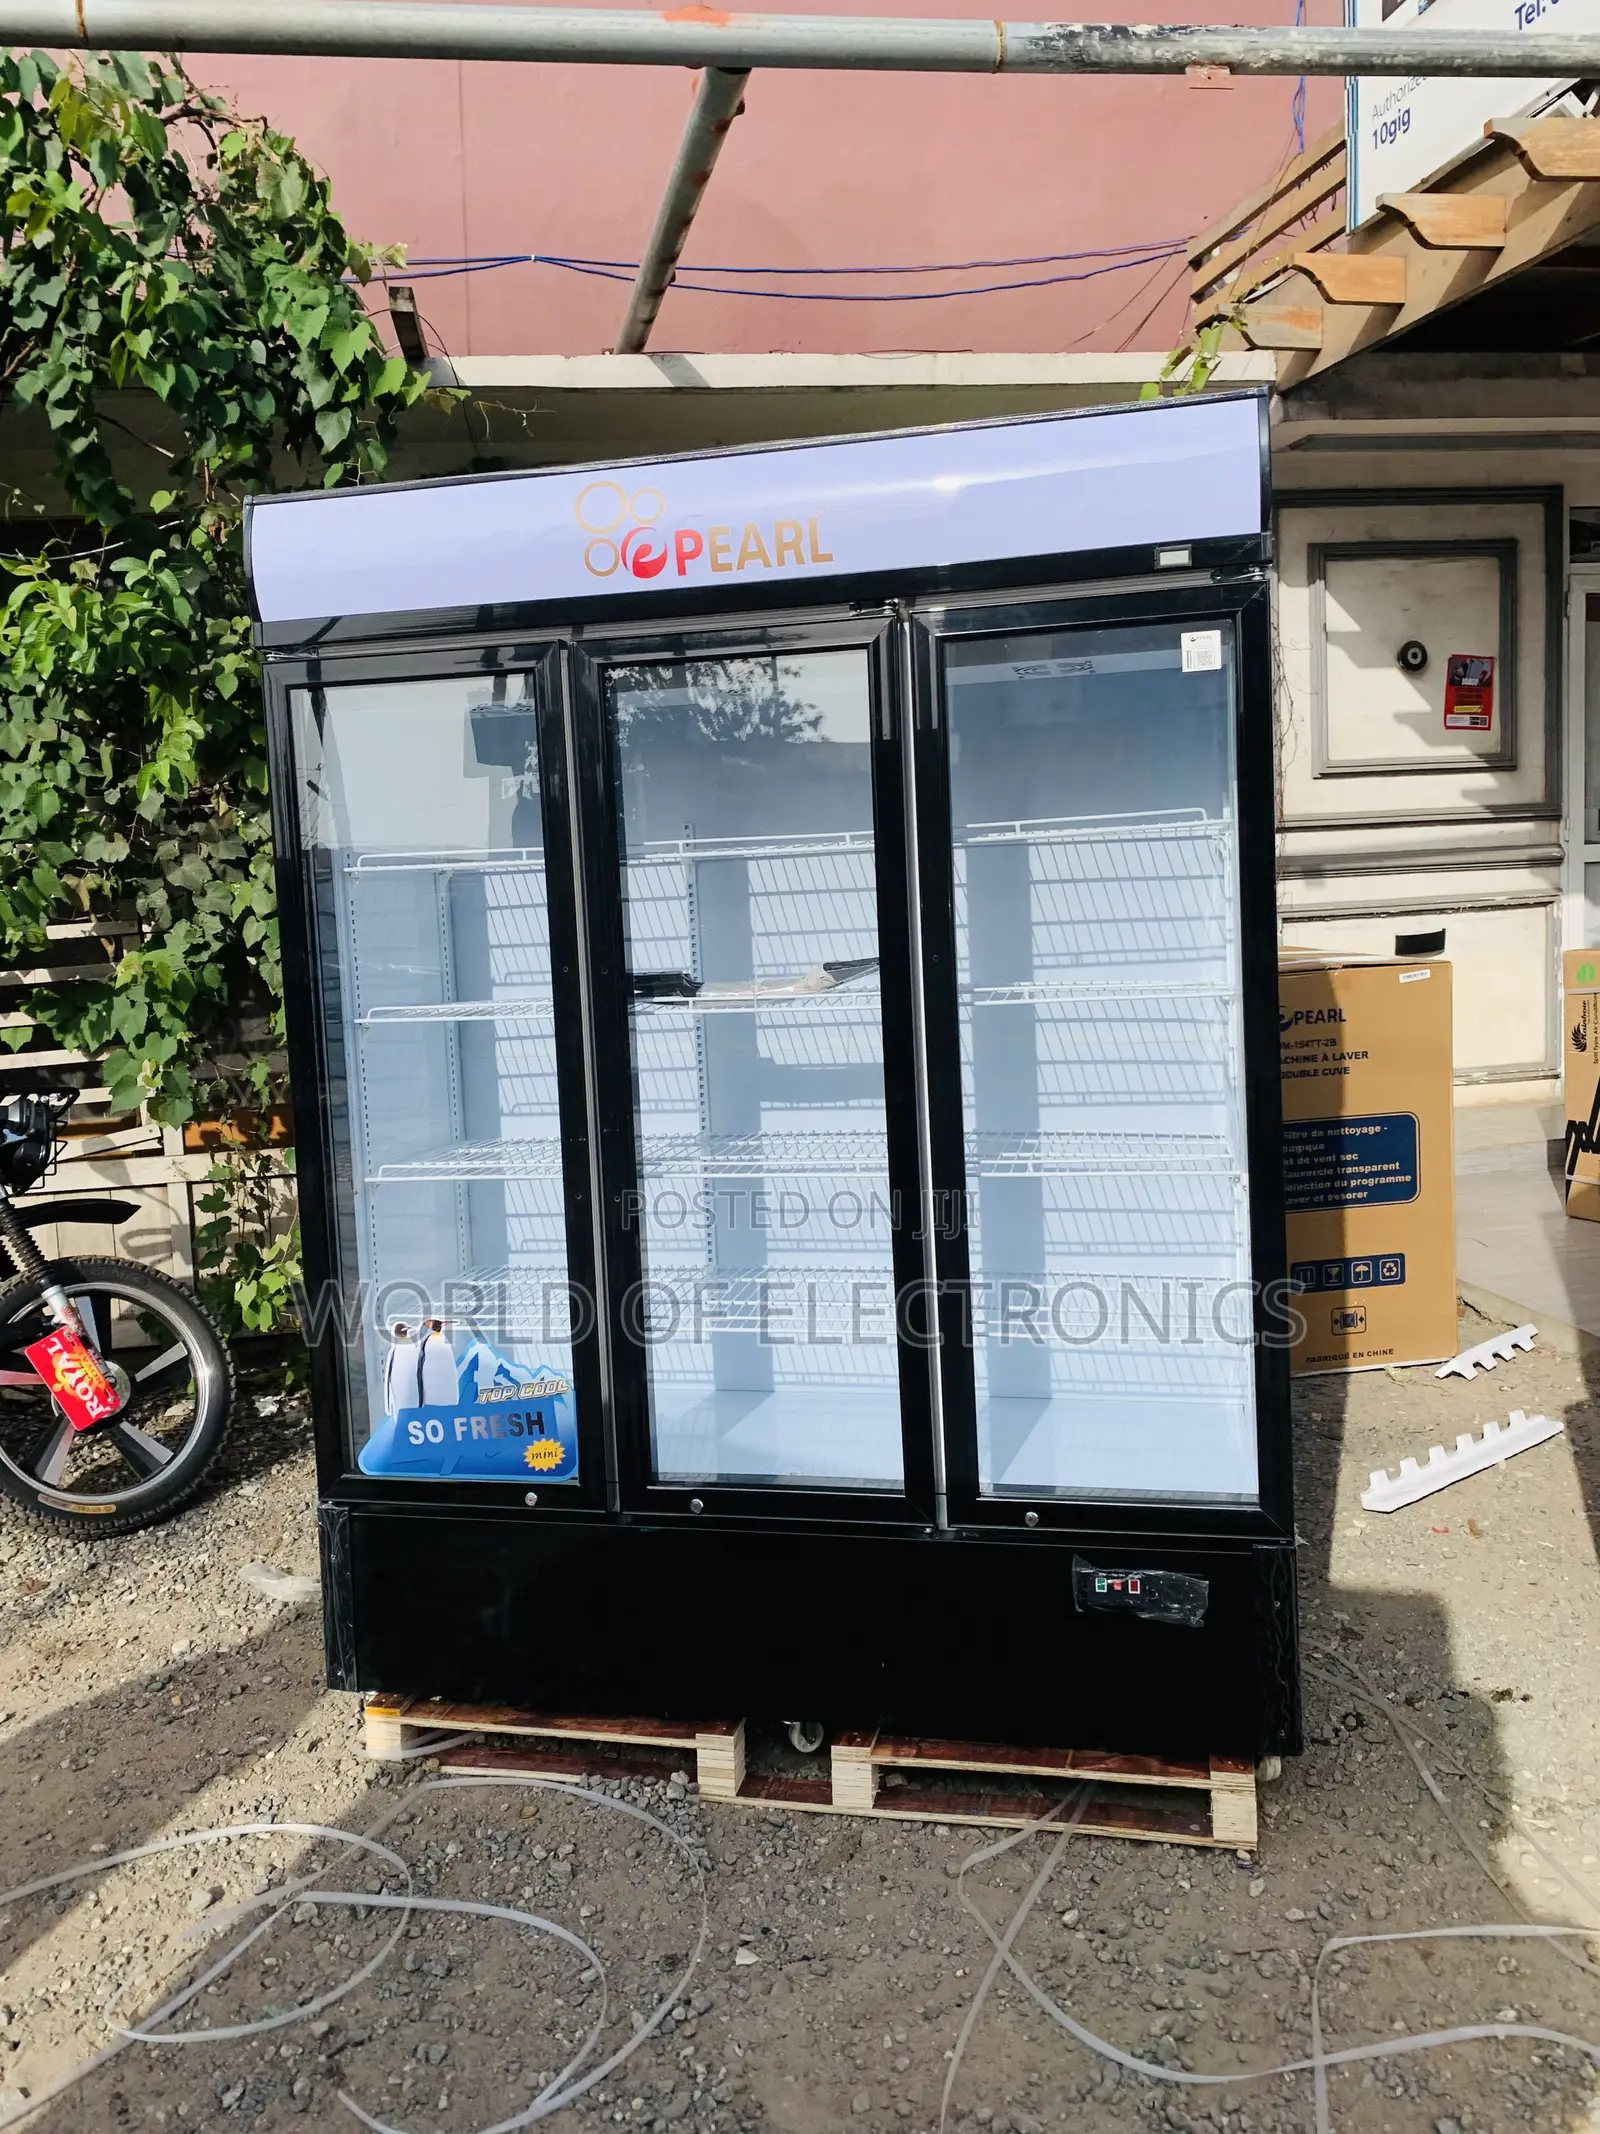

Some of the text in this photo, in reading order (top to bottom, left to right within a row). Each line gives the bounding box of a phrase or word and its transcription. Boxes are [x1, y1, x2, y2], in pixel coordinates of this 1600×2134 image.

[1372, 76, 1427, 120] Authorize
[1372, 107, 1411, 150] 10gig
[674, 517, 834, 577] PEARL
[1294, 1008, 1347, 1025] PEARL
[1332, 1050, 1369, 1061] LAVER
[1322, 1066, 1350, 1077] CUVE
[1311, 1129, 1324, 1137] de
[1327, 1125, 1382, 1136] nettoyage
[1297, 1157, 1310, 1165] de
[1313, 1154, 1336, 1163] vent
[1340, 1152, 1359, 1161] sec
[1337, 1161, 1400, 1175] transparent
[1334, 1179, 1347, 1188] du
[1350, 1174, 1412, 1188] programme
[1313, 1194, 1324, 1202] et
[1328, 1191, 1369, 1201] essorer
[1366, 1348, 1394, 1357] CHINE
[46, 1337, 112, 1419] ROYAL
[478, 1379, 570, 1405] TOP COOL
[407, 1411, 545, 1445] SO FRESH
[531, 1447, 559, 1461] mini
